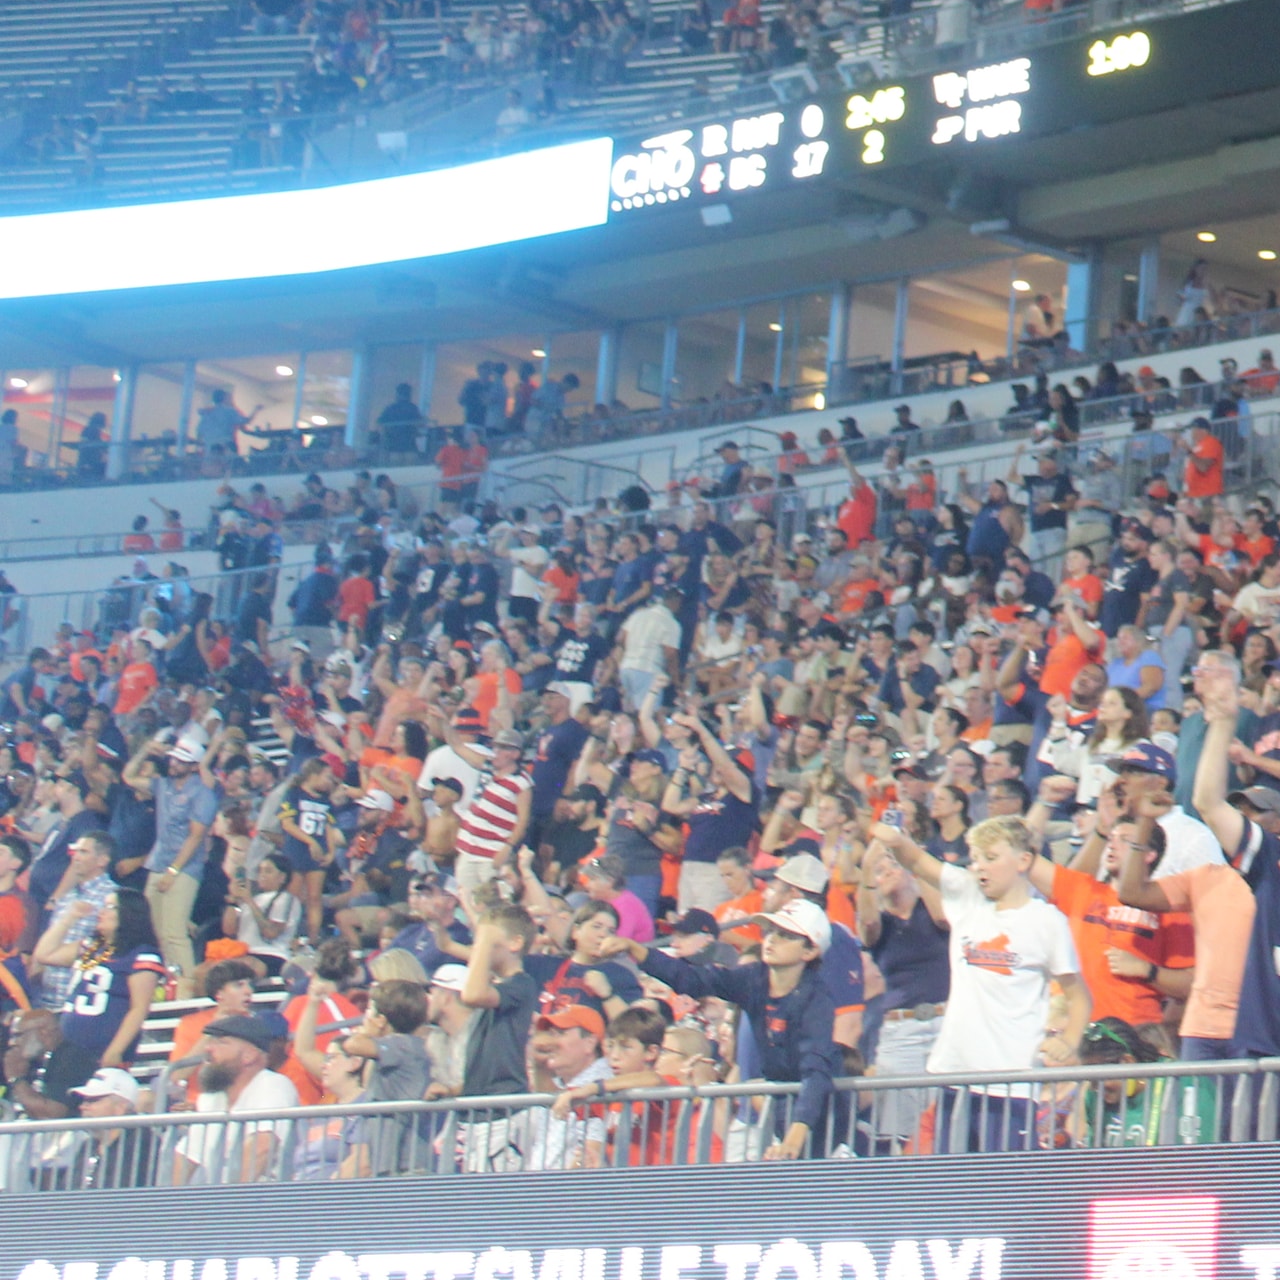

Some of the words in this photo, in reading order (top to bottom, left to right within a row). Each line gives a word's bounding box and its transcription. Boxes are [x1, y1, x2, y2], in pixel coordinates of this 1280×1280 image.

[802, 105, 823, 137] 0
[793, 142, 828, 177] 17
[863, 130, 884, 163] 2
